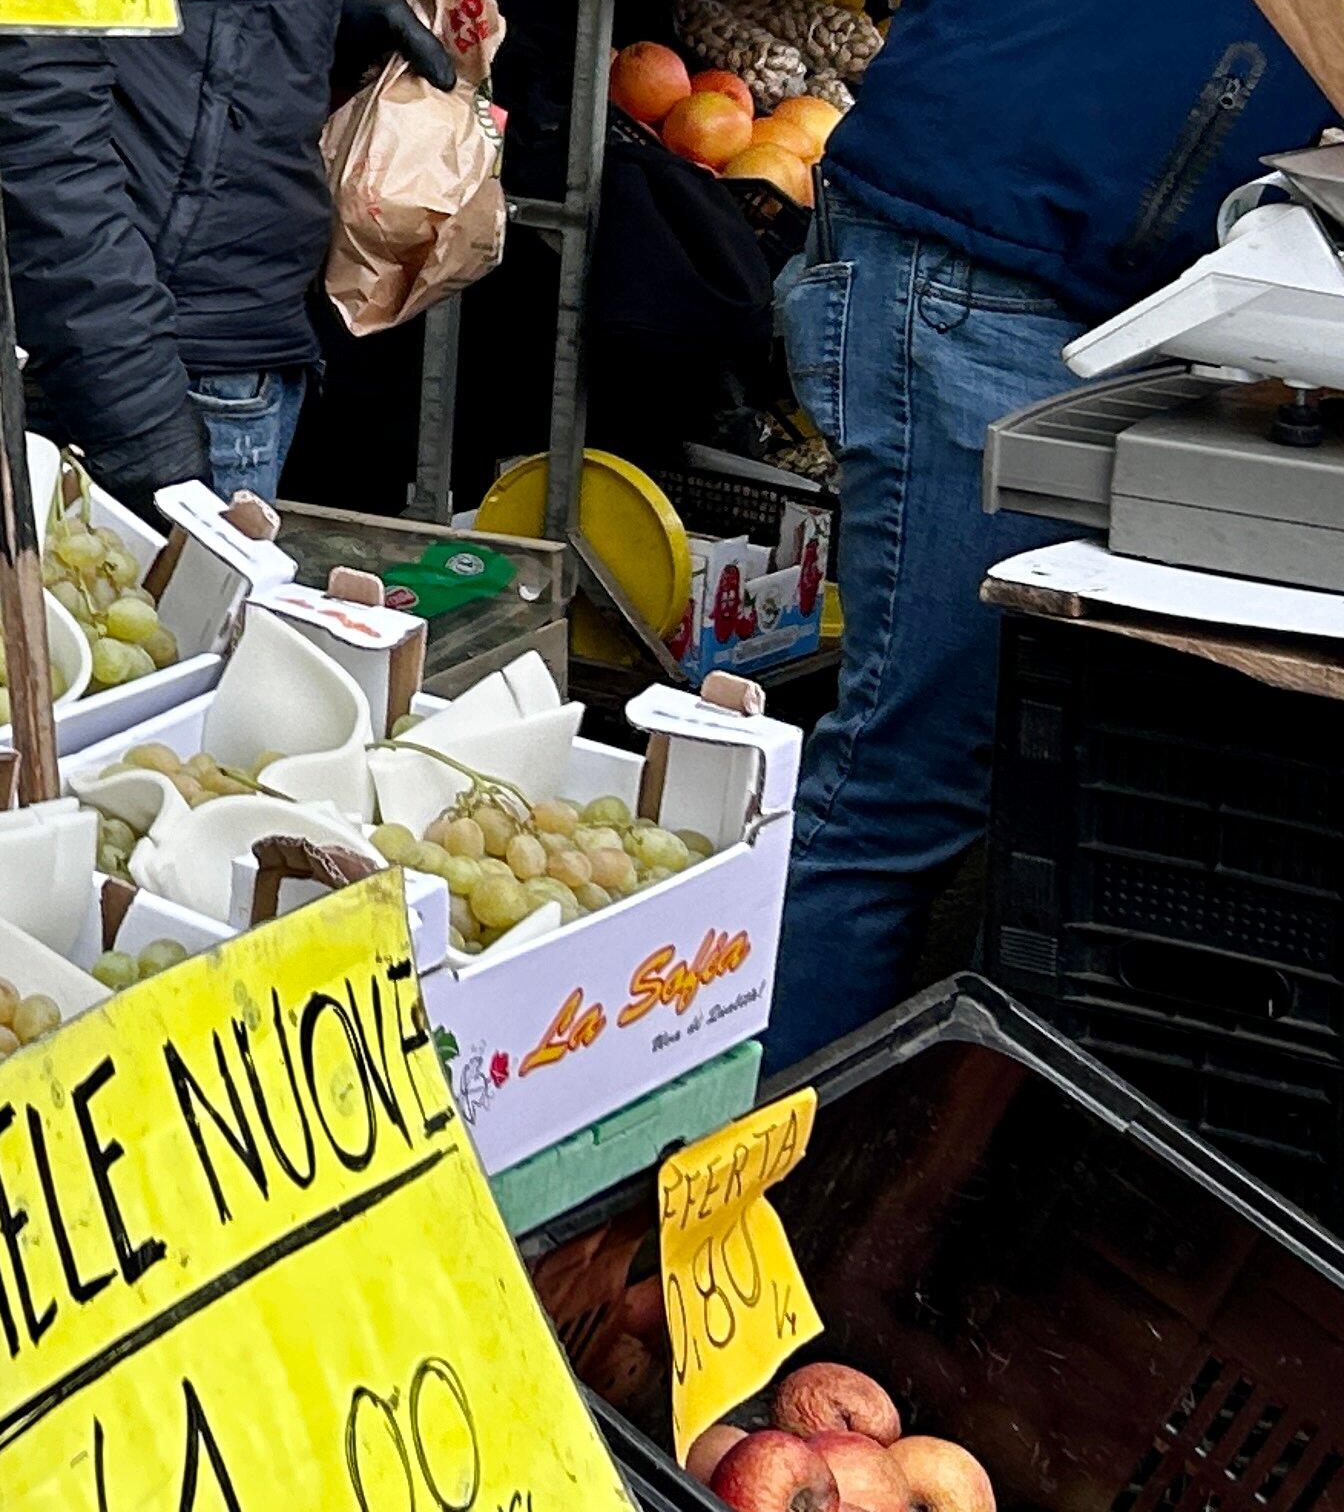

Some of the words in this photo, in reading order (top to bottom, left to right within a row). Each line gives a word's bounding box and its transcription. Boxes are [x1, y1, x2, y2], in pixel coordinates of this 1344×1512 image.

[163, 959, 456, 1225] NUOVE
[519, 987, 606, 1076] La
[617, 928, 751, 1028] Sofia
